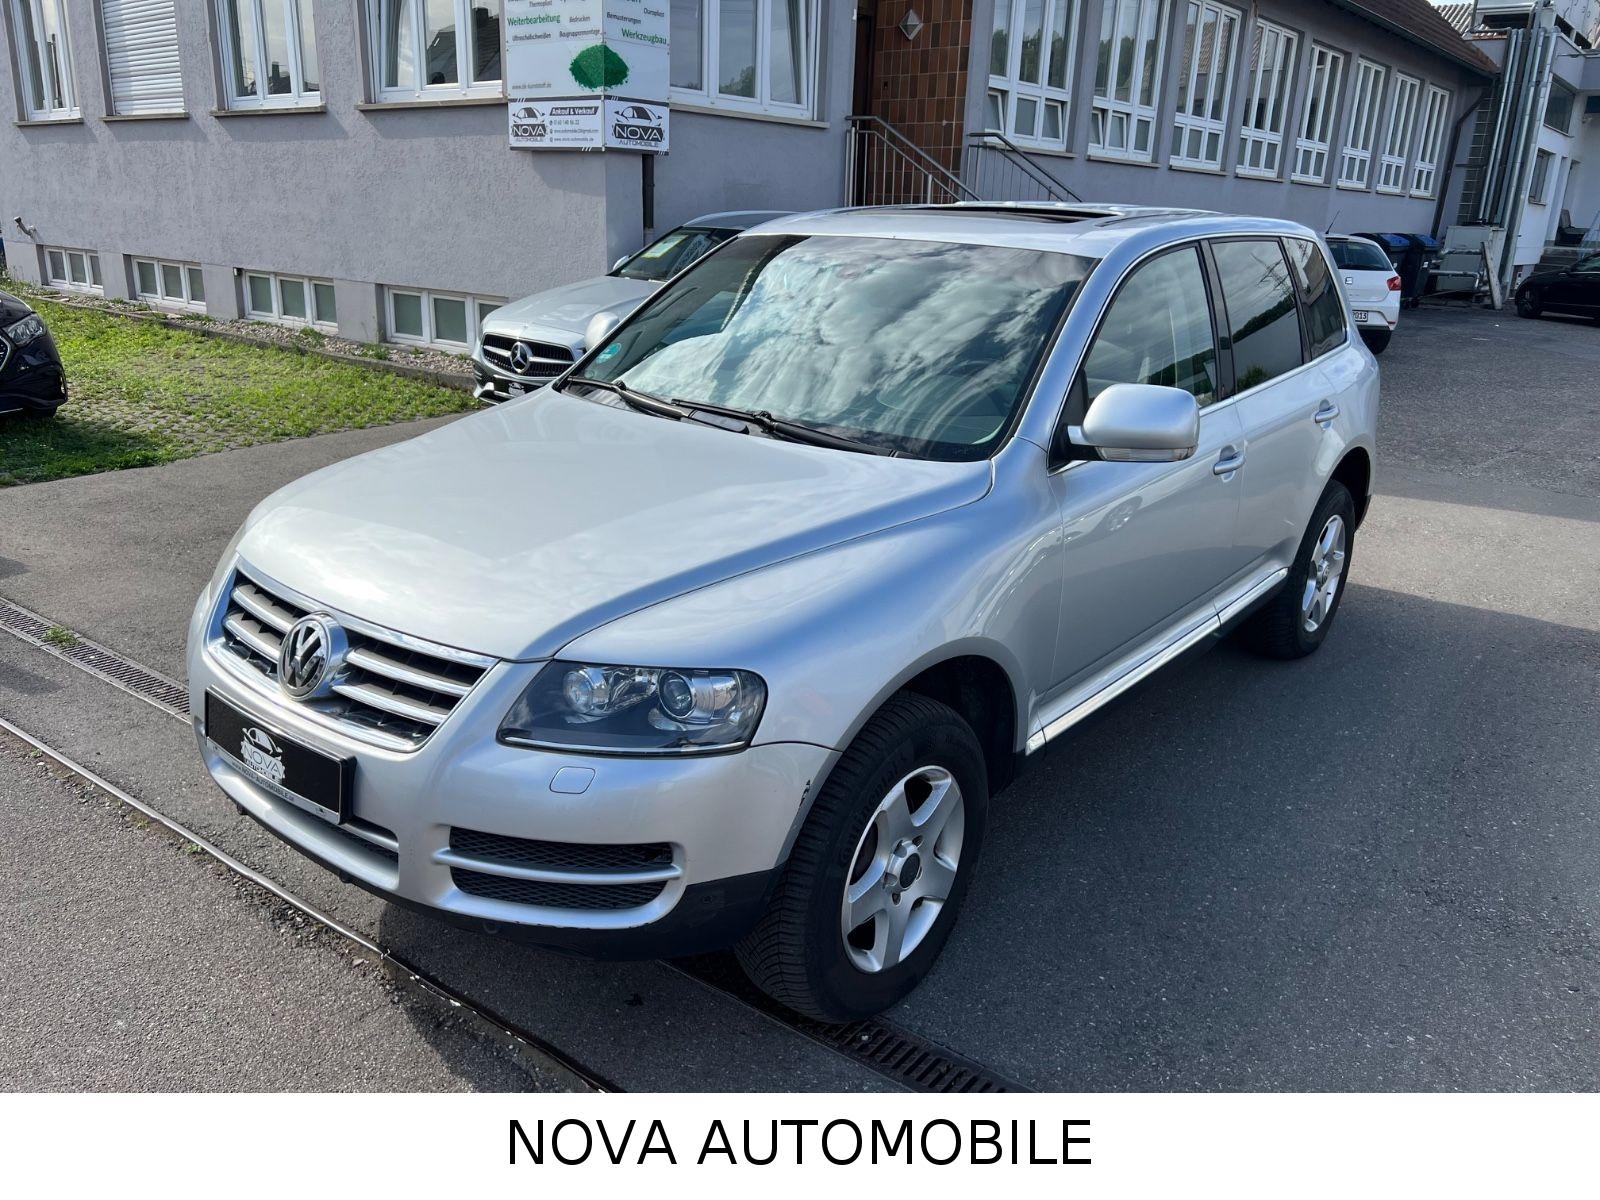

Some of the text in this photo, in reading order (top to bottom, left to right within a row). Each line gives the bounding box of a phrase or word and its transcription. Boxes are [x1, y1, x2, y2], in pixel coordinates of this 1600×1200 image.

[507, 13, 560, 26] Weiterbearbeitung
[606, 12, 641, 24] Bemusterungen
[621, 28, 667, 44] Werkzeugbau
[552, 108, 570, 116] Ankauf
[575, 107, 595, 115] Verkauf
[513, 126, 545, 136] NOVA
[615, 126, 662, 140] NOVA
[619, 139, 659, 147] AUTOMOBILE
[244, 744, 282, 777] NOVA
